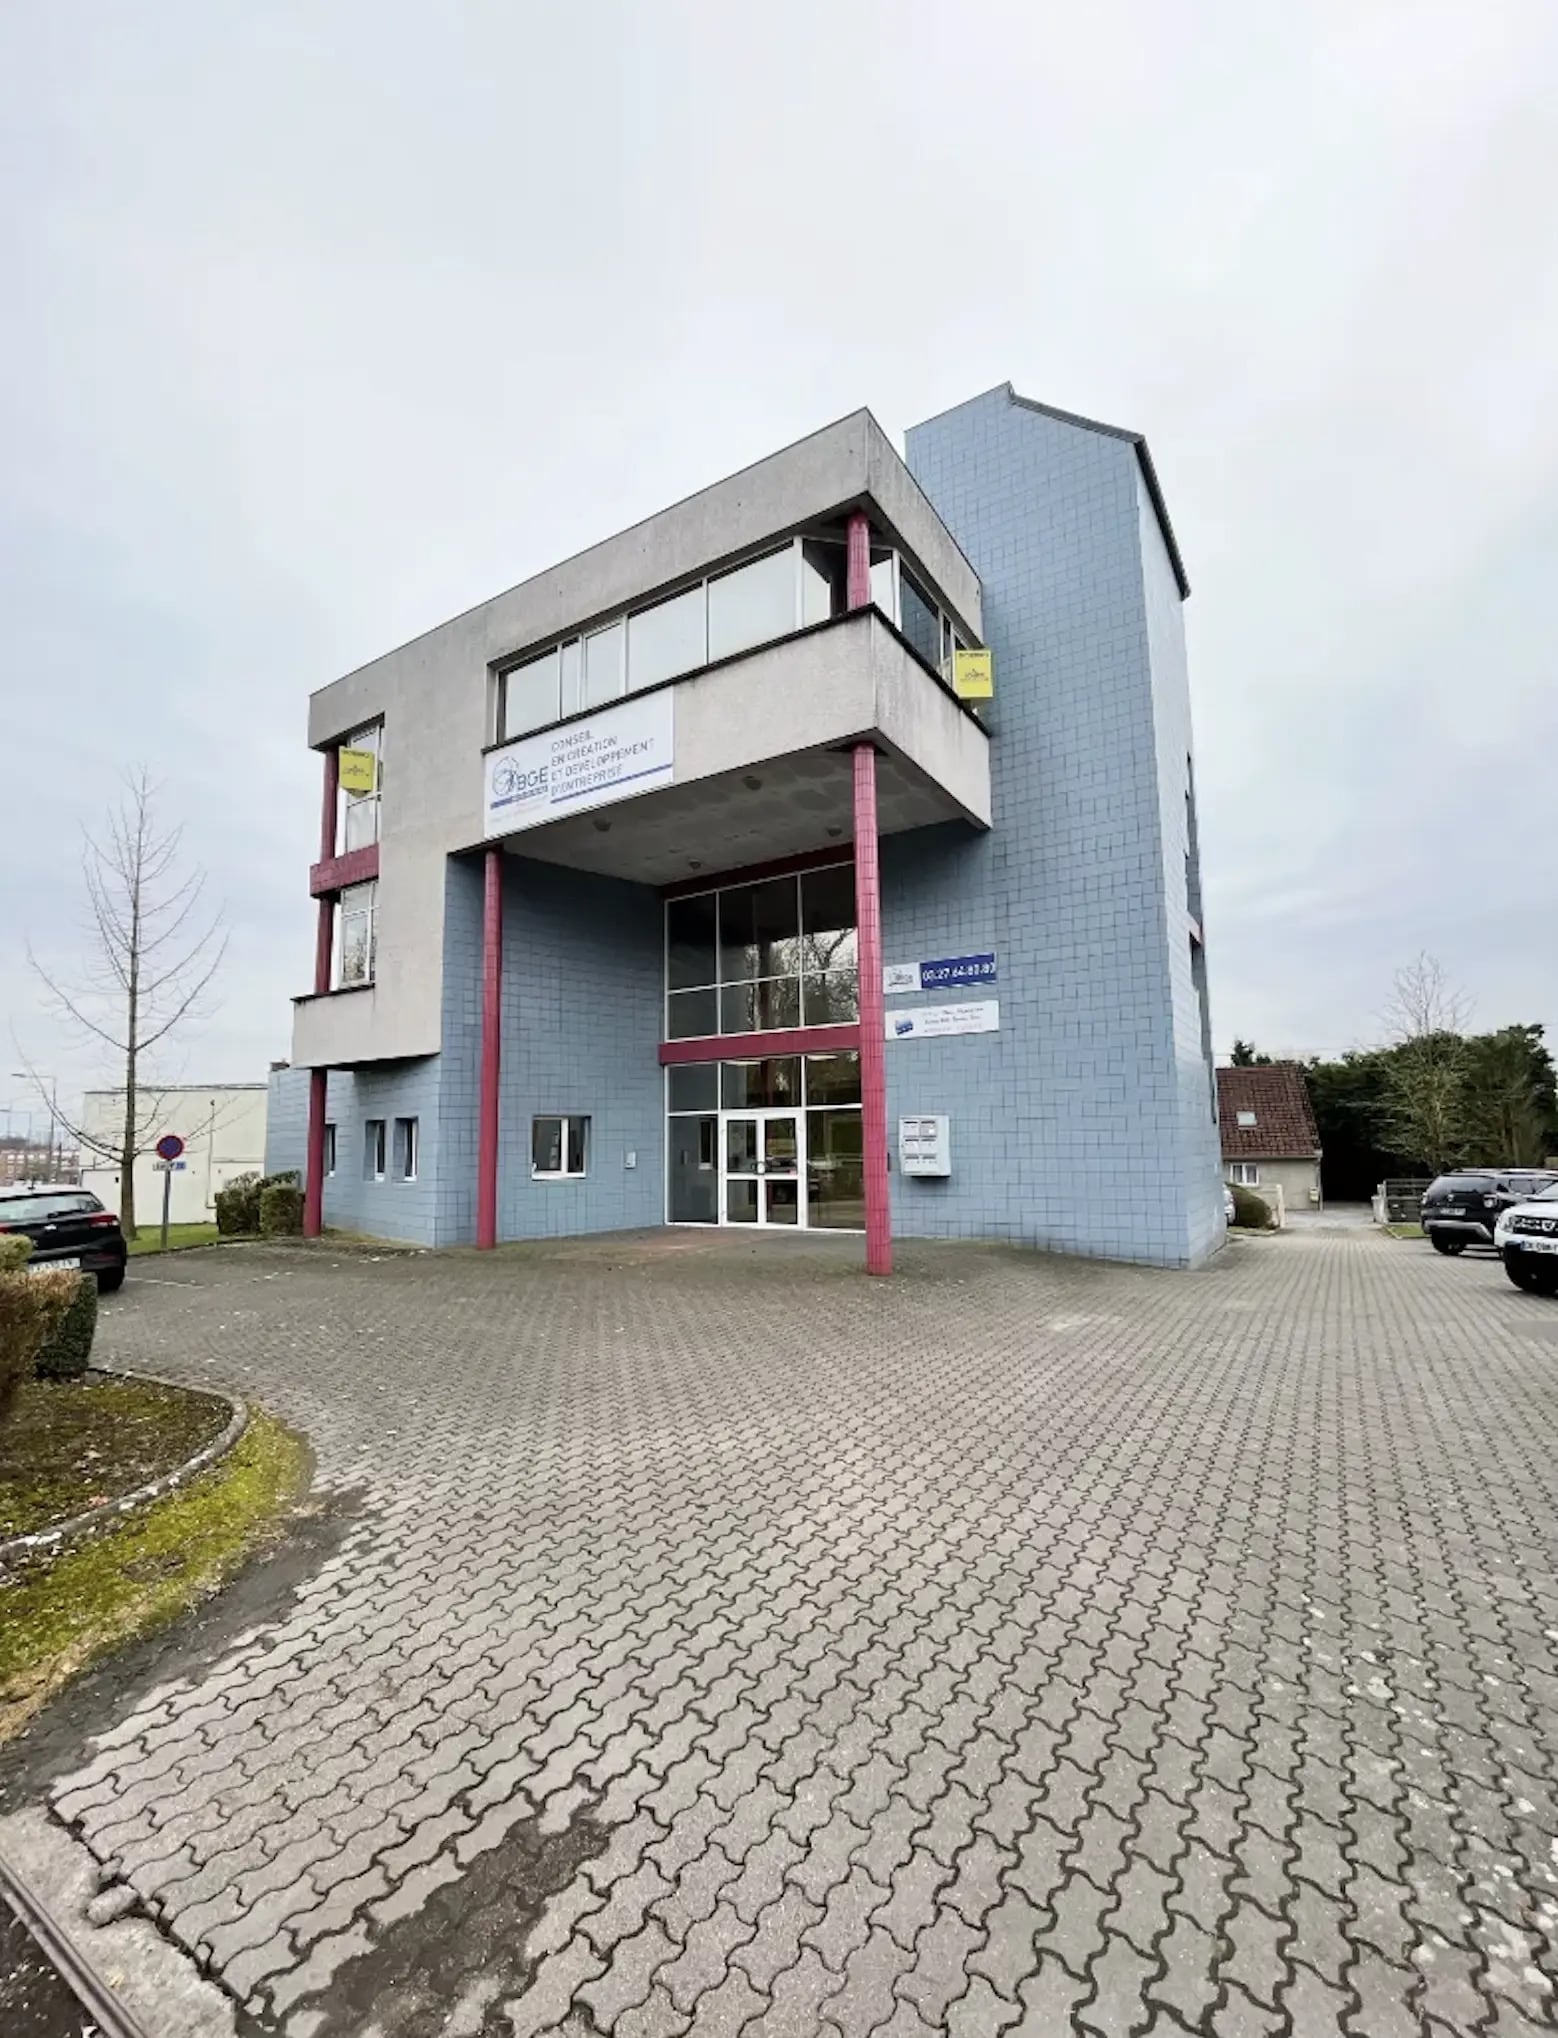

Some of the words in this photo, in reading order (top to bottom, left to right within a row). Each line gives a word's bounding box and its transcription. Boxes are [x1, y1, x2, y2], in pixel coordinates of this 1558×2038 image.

[551, 730, 594, 752] CONSEIL
[551, 754, 565, 767] EN
[516, 765, 549, 791] BGE
